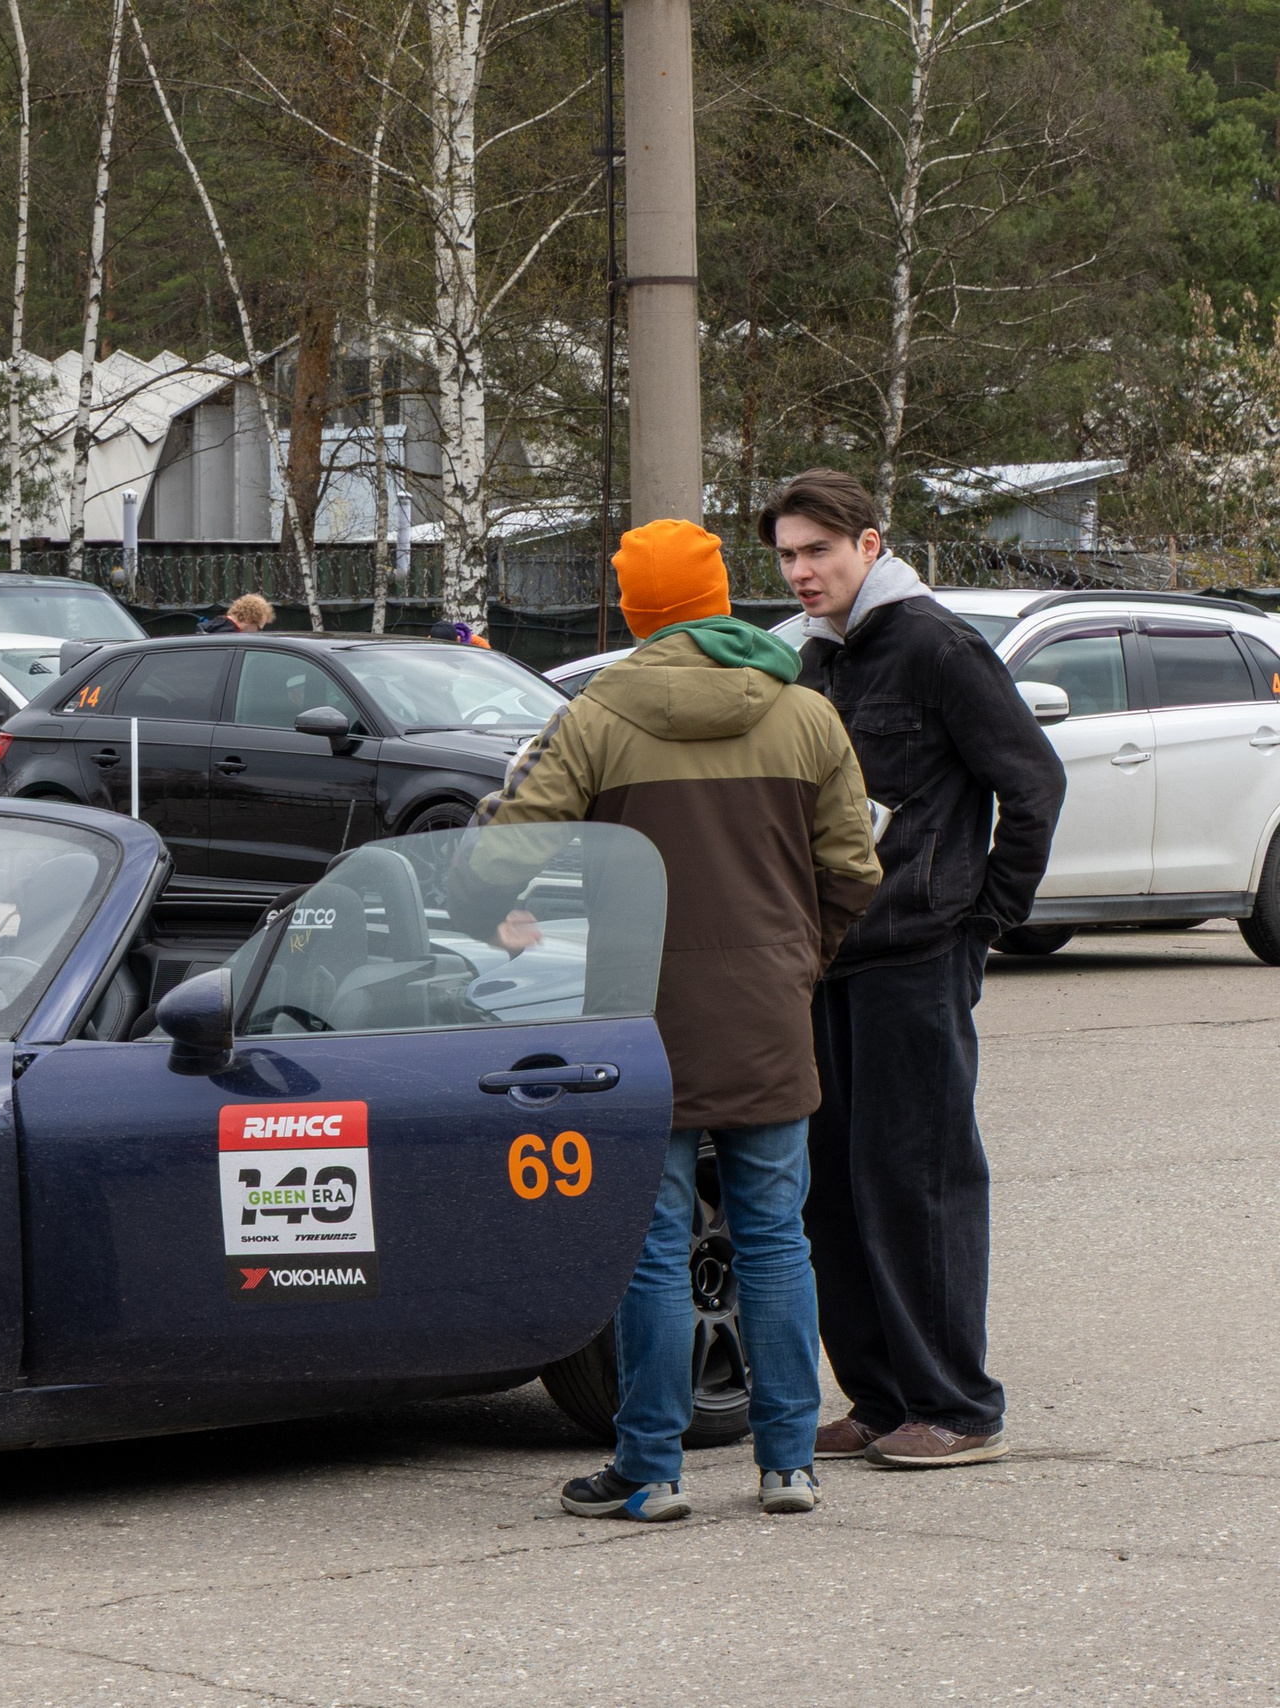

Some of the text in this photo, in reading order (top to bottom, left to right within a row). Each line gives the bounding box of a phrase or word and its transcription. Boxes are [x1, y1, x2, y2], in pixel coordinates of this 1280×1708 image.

[79, 686, 101, 708] 14
[243, 1115, 343, 1138] RHHCC
[508, 1130, 593, 1200] 69
[248, 1188, 347, 1205] GREEN ERA
[241, 1235, 280, 1243] SHONX
[295, 1233, 357, 1242] TYREWARS
[269, 1268, 367, 1287] YOKOHAMA
